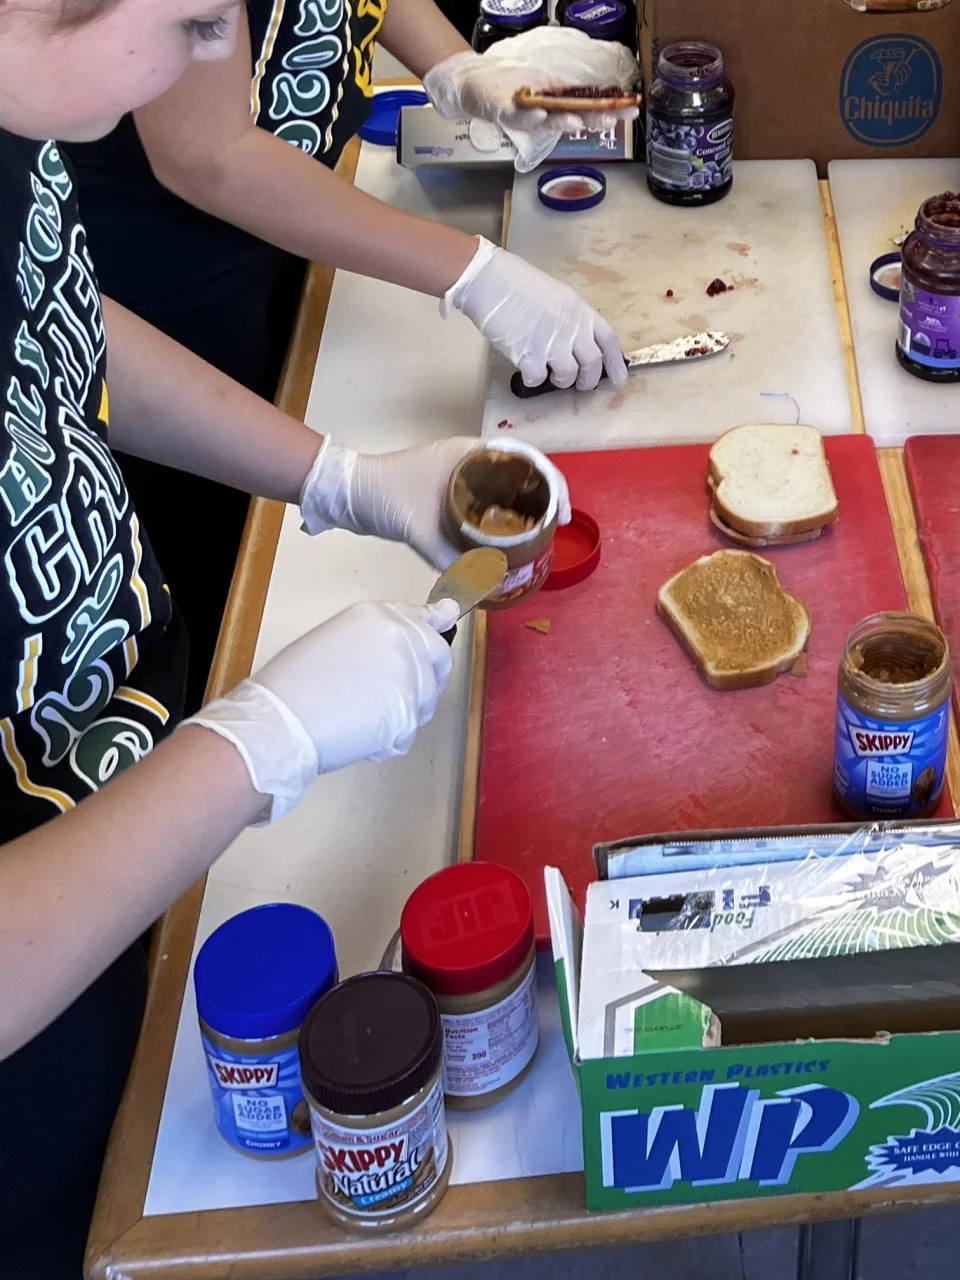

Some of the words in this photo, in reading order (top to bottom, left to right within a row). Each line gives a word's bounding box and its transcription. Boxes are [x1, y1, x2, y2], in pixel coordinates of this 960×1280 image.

[844, 95, 934, 126] Chiquita
[855, 732, 911, 753] SKIPPY
[871, 770, 909, 781] SUGAR
[880, 765, 900, 774] NO
[870, 778, 909, 787] ADDED
[710, 910, 756, 932] Food
[471, 1050, 487, 1061] 200
[214, 1062, 275, 1085] SKIPPY
[605, 1069, 716, 1090] WESTERN
[726, 1059, 832, 1081] PLASTICS
[236, 1103, 281, 1115] SUGAR
[246, 1099, 268, 1107] NO
[238, 1111, 282, 1121] ADDED
[599, 1081, 861, 1194] WP
[317, 1139, 405, 1174] SKIPPY
[893, 1144, 920, 1155] SAFE
[922, 1140, 952, 1152] EDGE
[904, 1153, 937, 1162] HANDLE
[332, 1146, 421, 1197] Natural
[359, 1179, 408, 1205] Creamy
